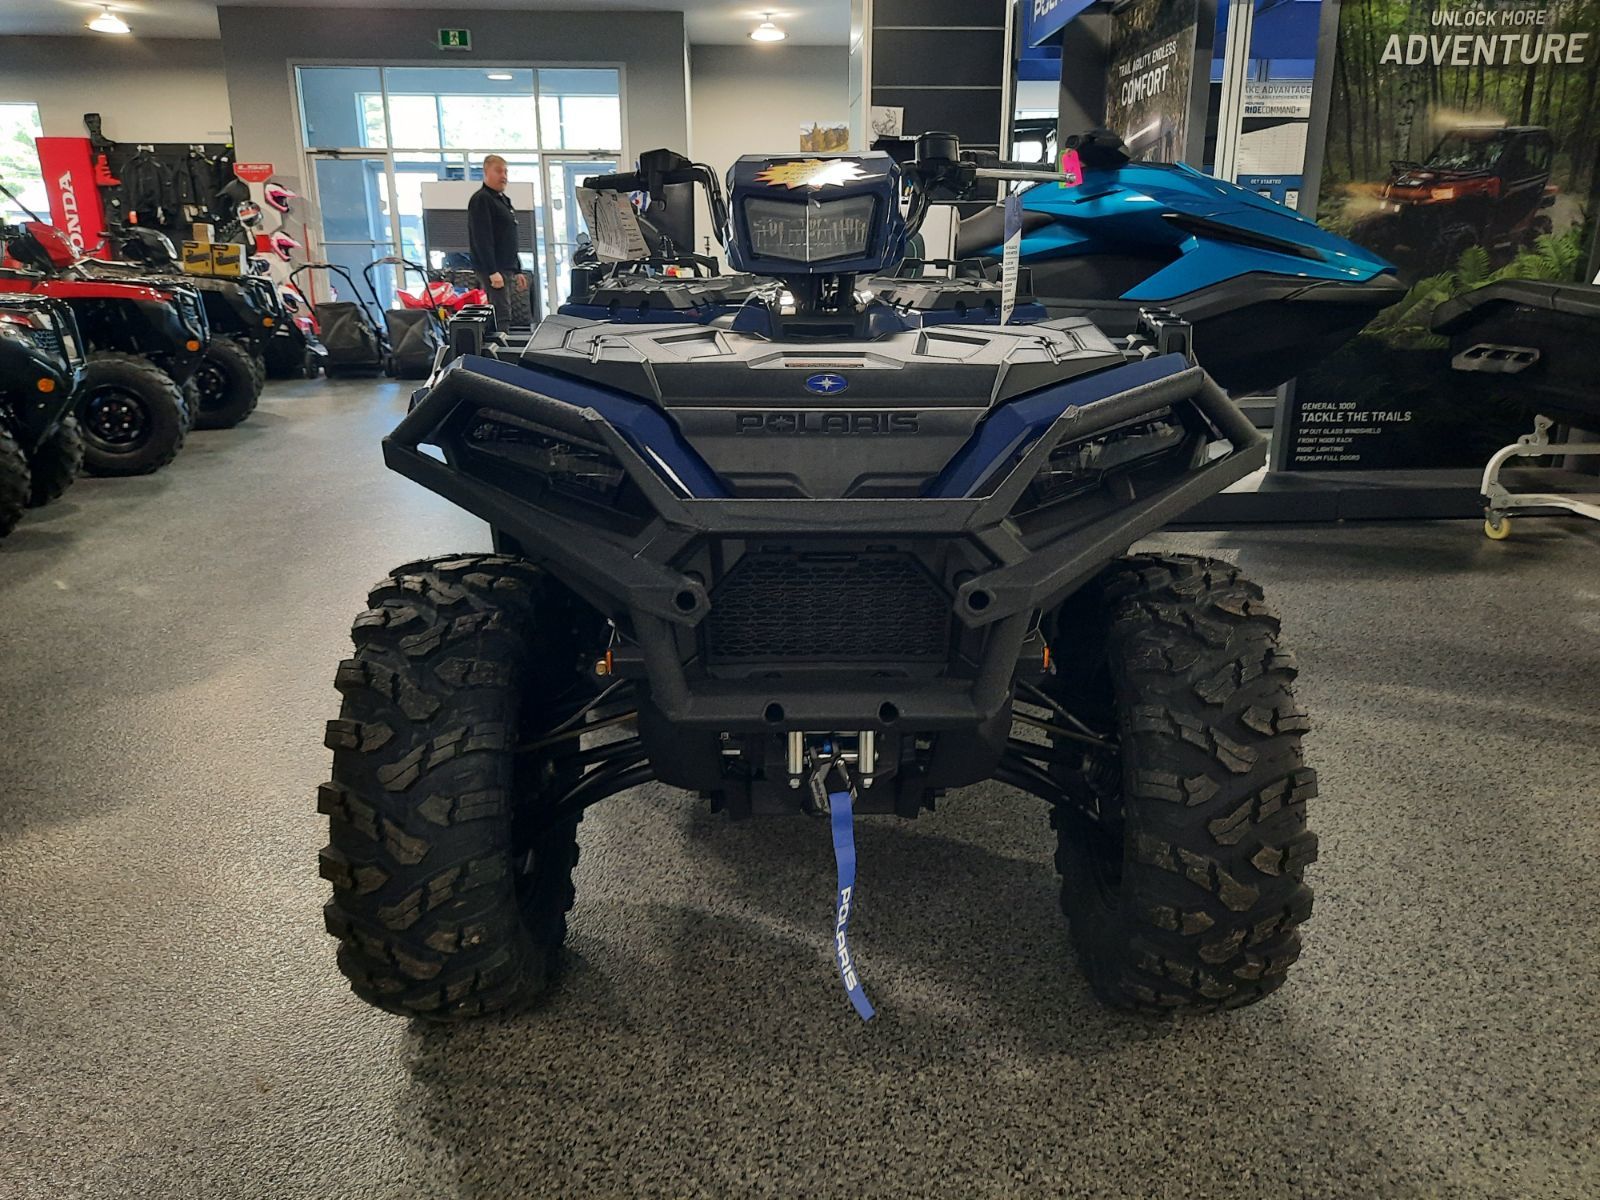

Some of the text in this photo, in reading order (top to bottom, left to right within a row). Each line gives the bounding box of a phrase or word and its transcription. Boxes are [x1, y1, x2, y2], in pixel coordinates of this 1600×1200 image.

[1432, 9, 1547, 26] UNLOCK MORE
[1152, 41, 1177, 63] ENDLESS
[1379, 33, 1590, 65] ADVENTURE
[1121, 64, 1169, 106] COMFORT
[1262, 85, 1312, 94] ADVANTAGE
[59, 170, 85, 252] ONDA
[1301, 402, 1337, 410] GENERAL
[1301, 411, 1412, 422] TACKLE THE TRAILS
[735, 413, 921, 435] POLARIS
[836, 887, 857, 991] POLARIS
